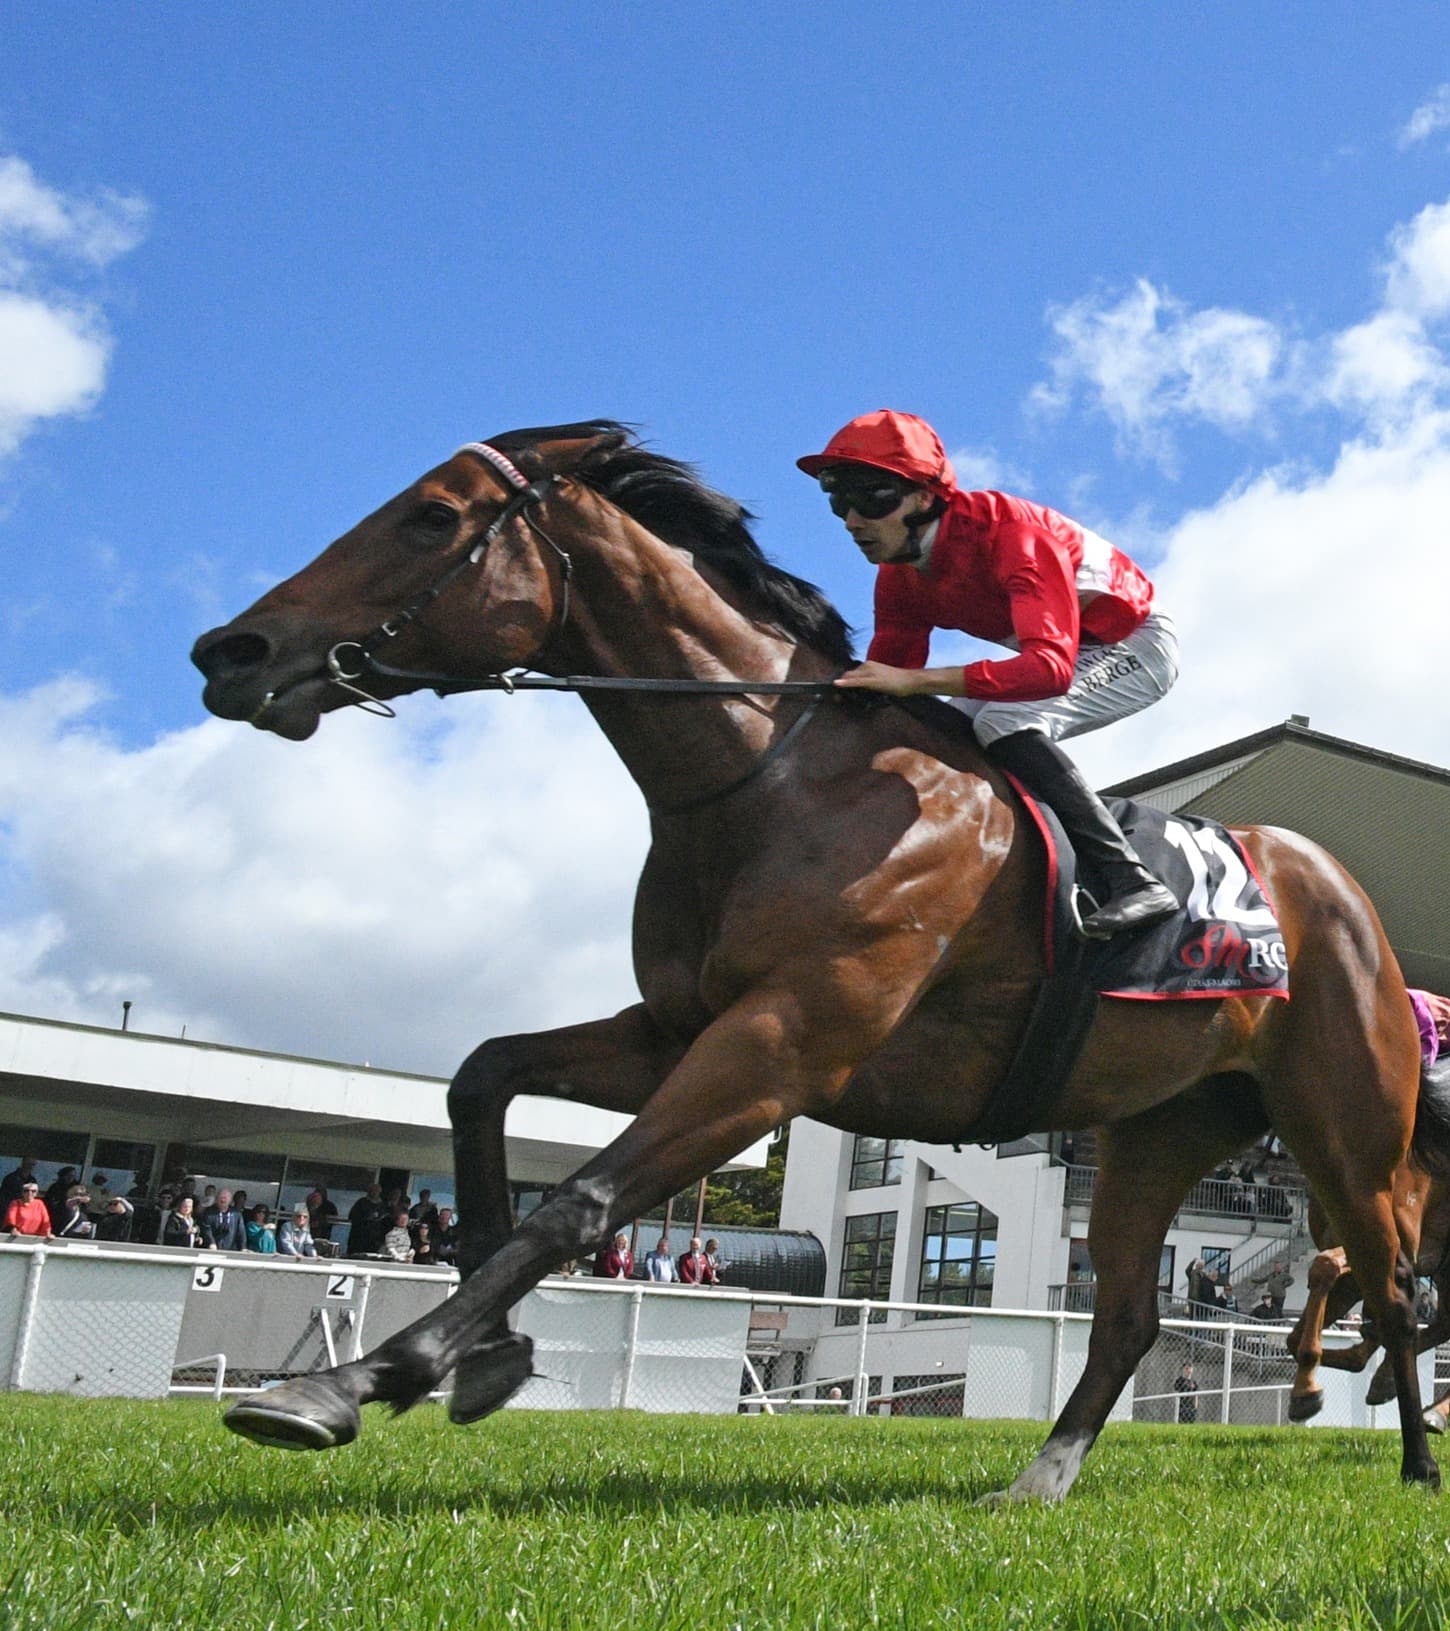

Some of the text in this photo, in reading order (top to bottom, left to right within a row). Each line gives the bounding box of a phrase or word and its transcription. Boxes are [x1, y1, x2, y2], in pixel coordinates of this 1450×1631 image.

[1081, 655, 1142, 692] BERGE
[1164, 820, 1279, 927] 12
[195, 1265, 219, 1288] 3
[328, 1275, 348, 1296] 2
